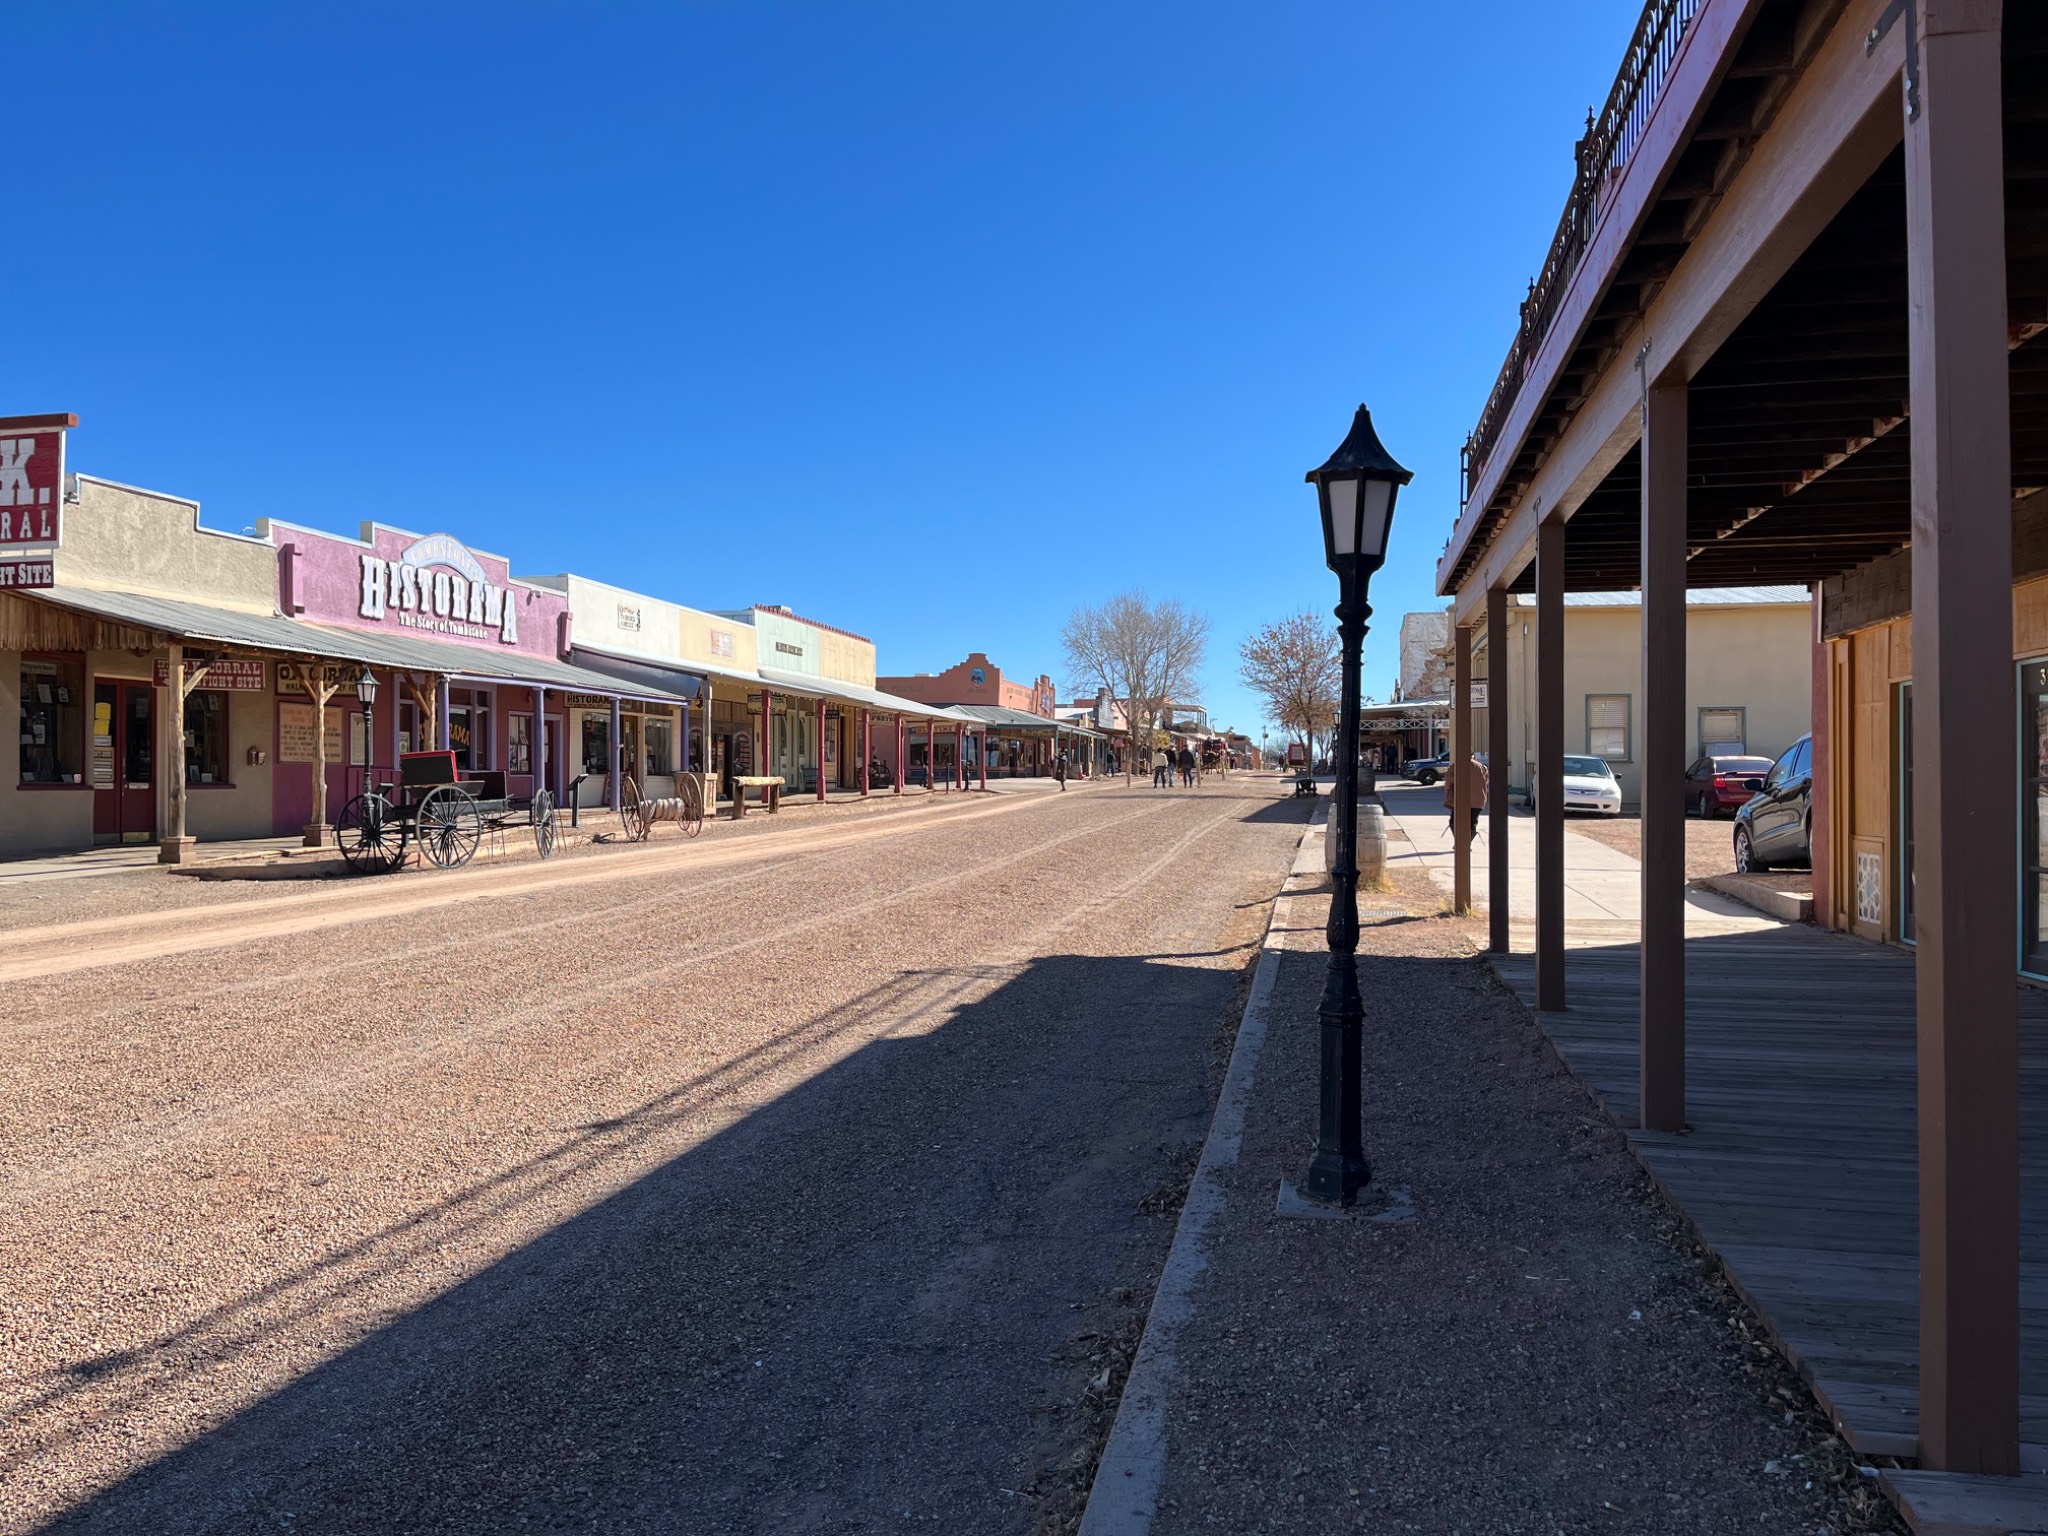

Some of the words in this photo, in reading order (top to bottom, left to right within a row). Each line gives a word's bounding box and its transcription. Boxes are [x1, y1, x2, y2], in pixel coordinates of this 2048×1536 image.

[18, 563, 52, 585] SITE
[360, 553, 518, 644] HISTORAMA
[399, 611, 416, 628] The
[417, 615, 438, 635] Story
[440, 620, 449, 633] of
[449, 620, 488, 639] Tombstone
[208, 662, 261, 675] CORRAL
[236, 676, 262, 689] SITE
[567, 694, 610, 704] HISTORAM
